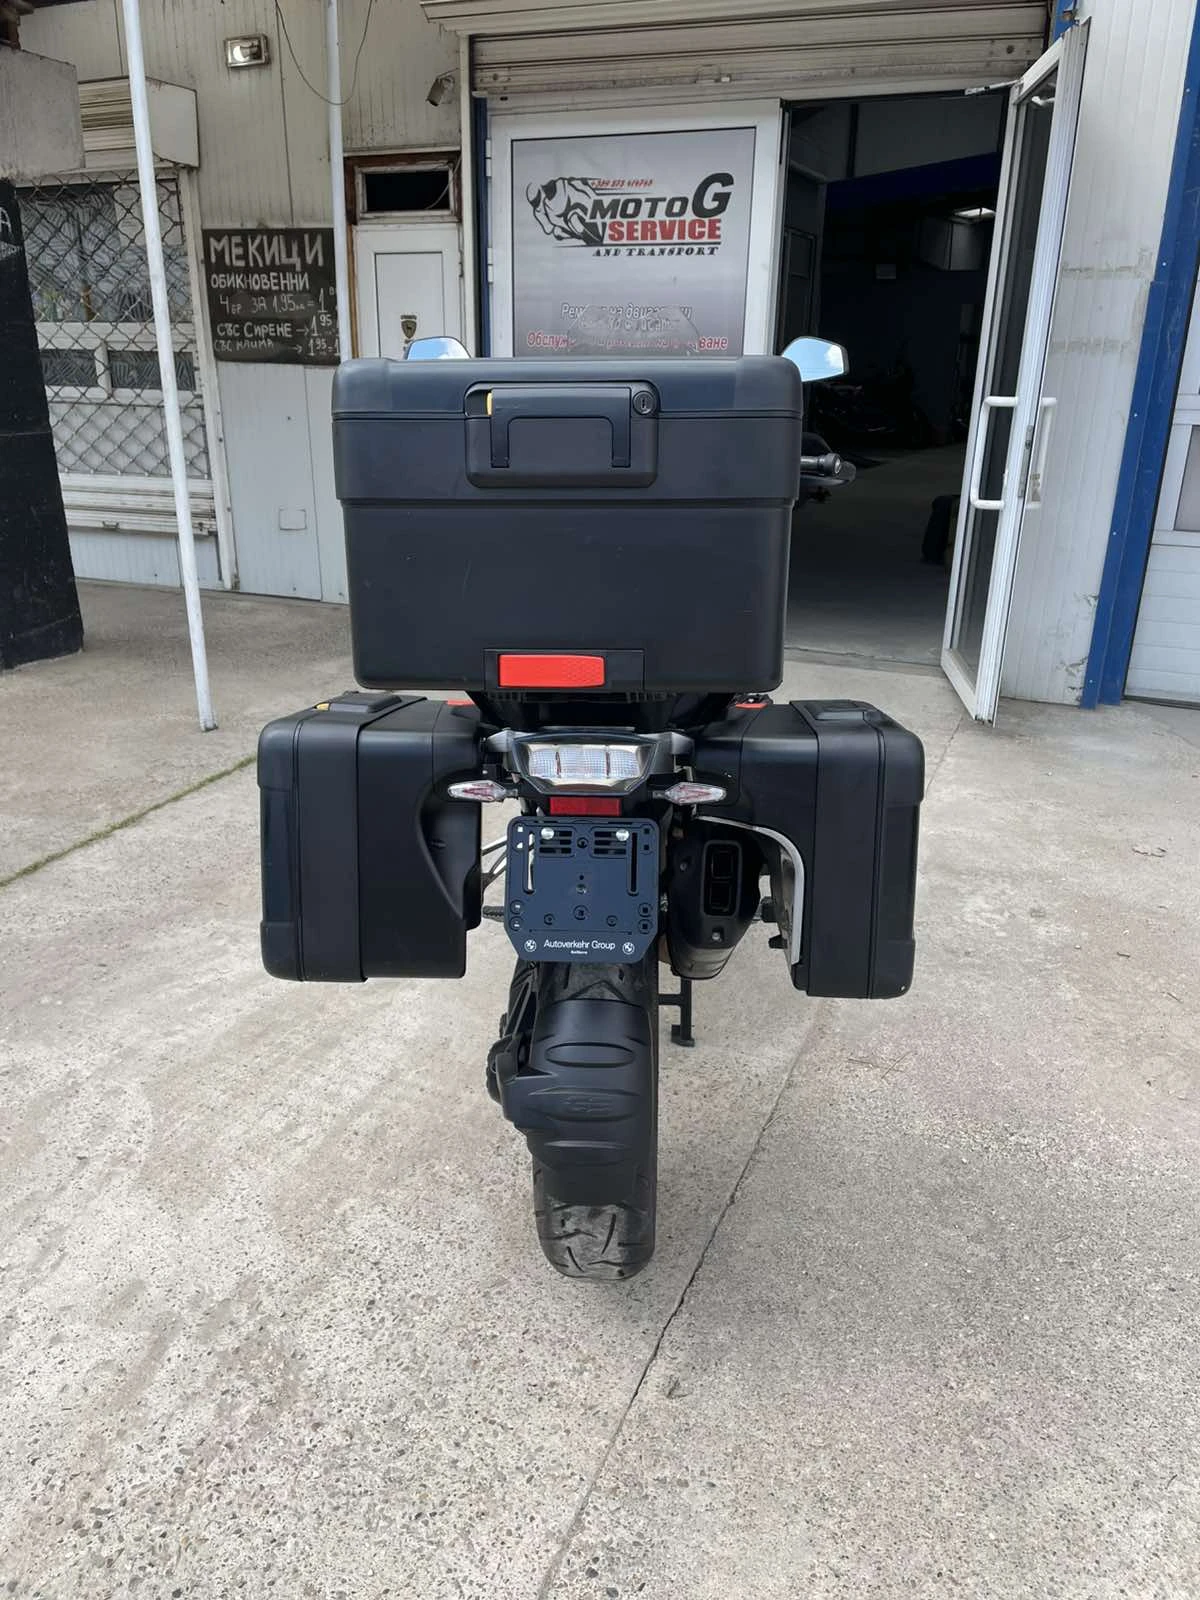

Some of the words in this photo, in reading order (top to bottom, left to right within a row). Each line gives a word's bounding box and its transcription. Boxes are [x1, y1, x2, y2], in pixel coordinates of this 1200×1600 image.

[607, 219, 722, 242] SERVICE
[209, 233, 325, 271] МЕКИЦИ
[592, 247, 624, 257] AND
[625, 246, 719, 256] TRANSPORT
[210, 271, 310, 291] ОБИКНОВЕННИ
[543, 939, 590, 949] Autoverkehr
[591, 940, 616, 951] Group
